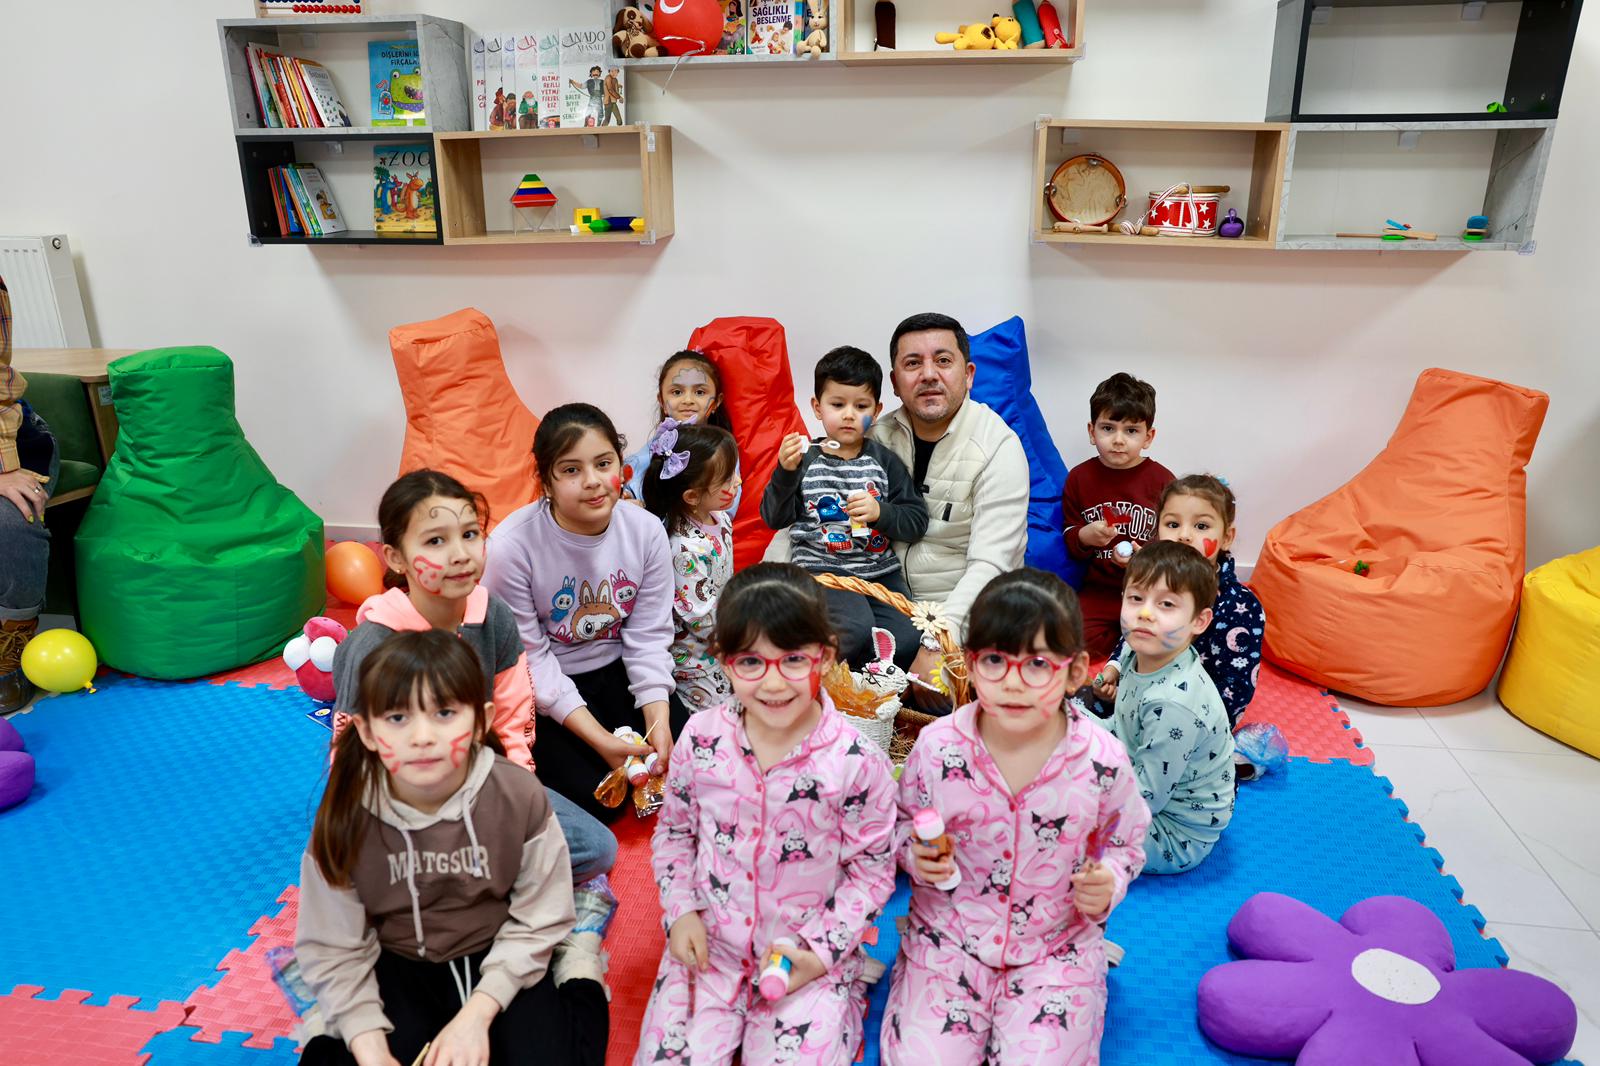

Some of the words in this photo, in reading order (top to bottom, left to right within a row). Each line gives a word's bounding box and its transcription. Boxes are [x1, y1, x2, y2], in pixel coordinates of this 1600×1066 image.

[752, 4, 788, 17] SAĞLIKLI
[756, 15, 792, 25] BESLENME
[561, 31, 606, 47] ANADO
[1116, 501, 1157, 541] YOR
